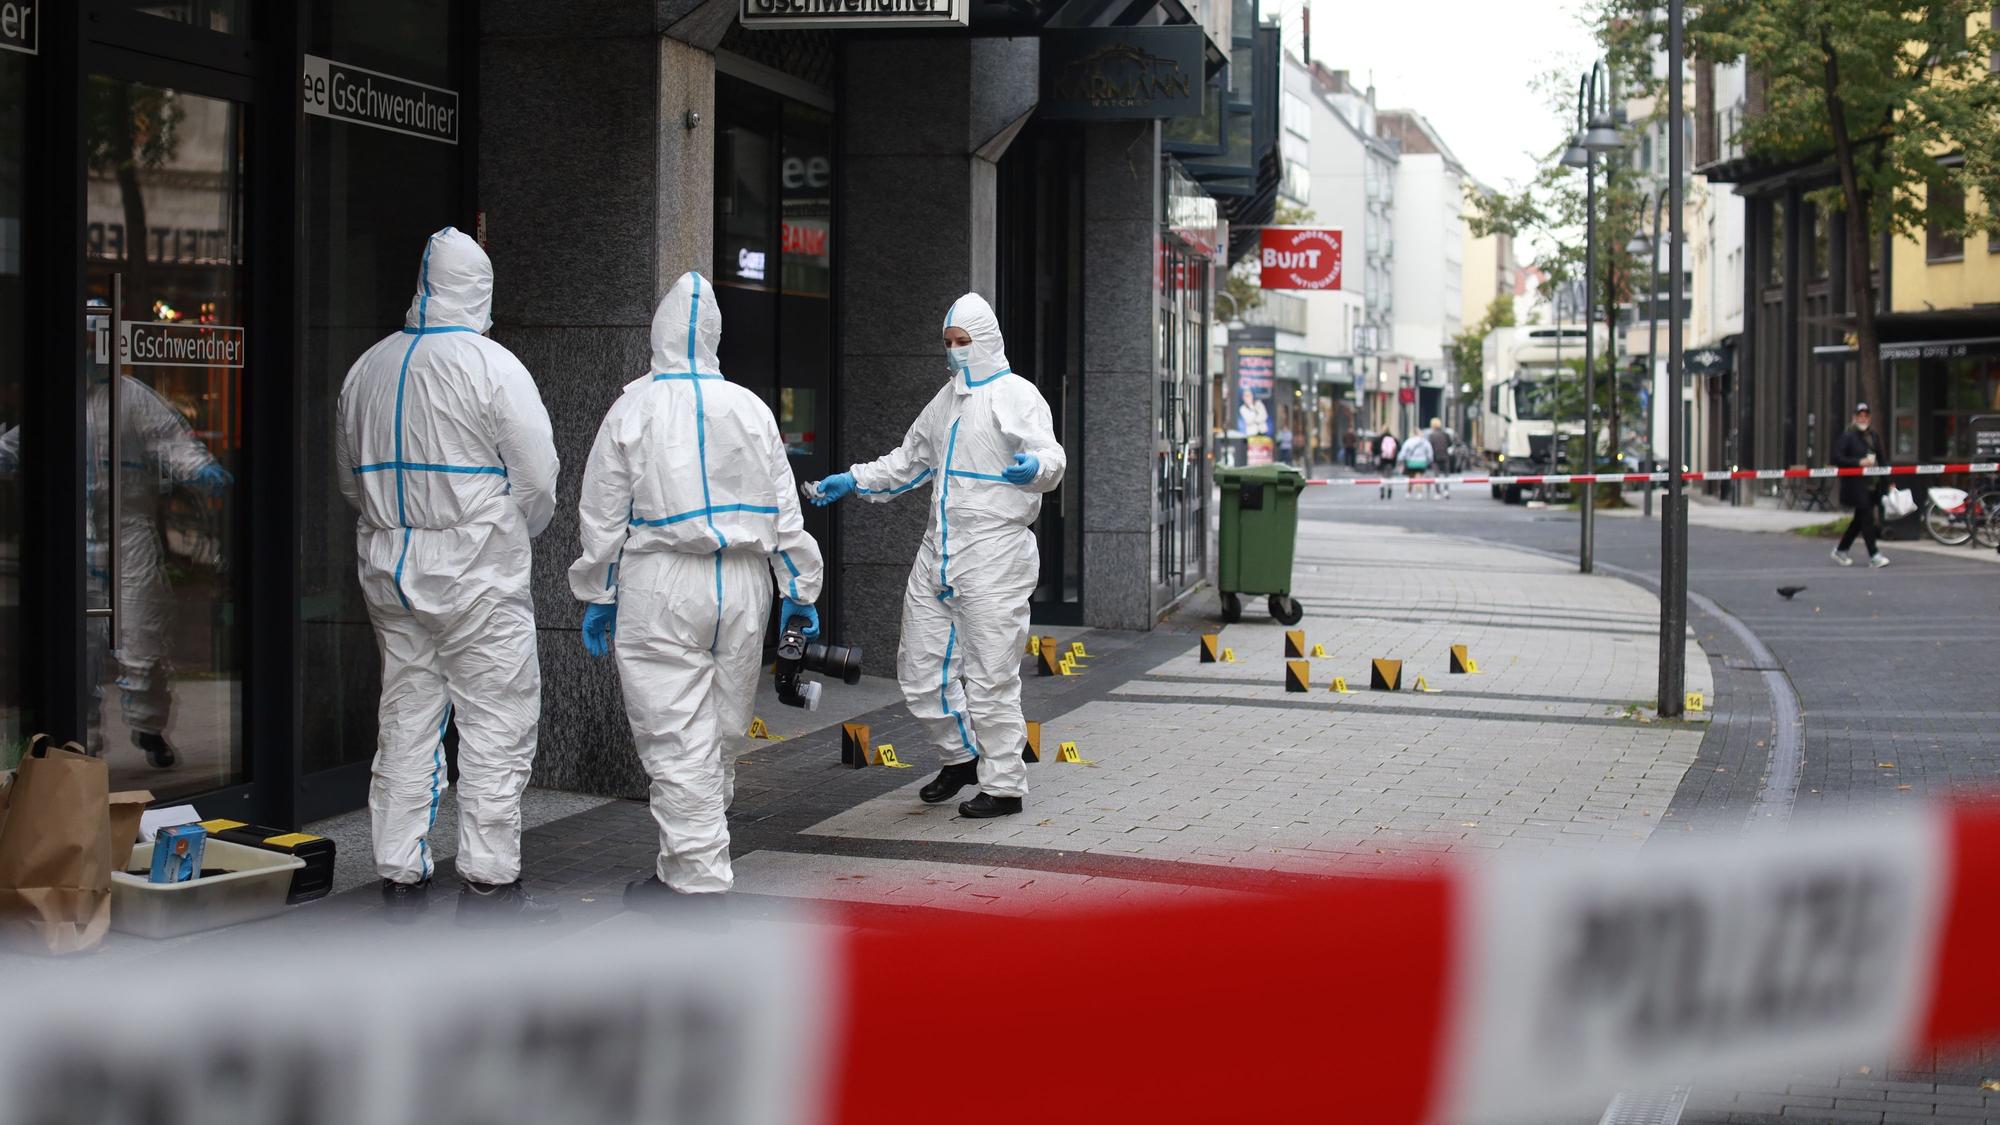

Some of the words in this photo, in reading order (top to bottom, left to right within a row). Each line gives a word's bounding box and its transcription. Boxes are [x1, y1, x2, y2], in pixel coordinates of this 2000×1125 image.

[332, 72, 454, 134] Gschwendner
[98, 326, 128, 358] Te
[133, 328, 241, 361] Gschwendner
[1689, 697, 1700, 707] 14
[882, 749, 895, 762] 12
[1066, 746, 1077, 759] 11
